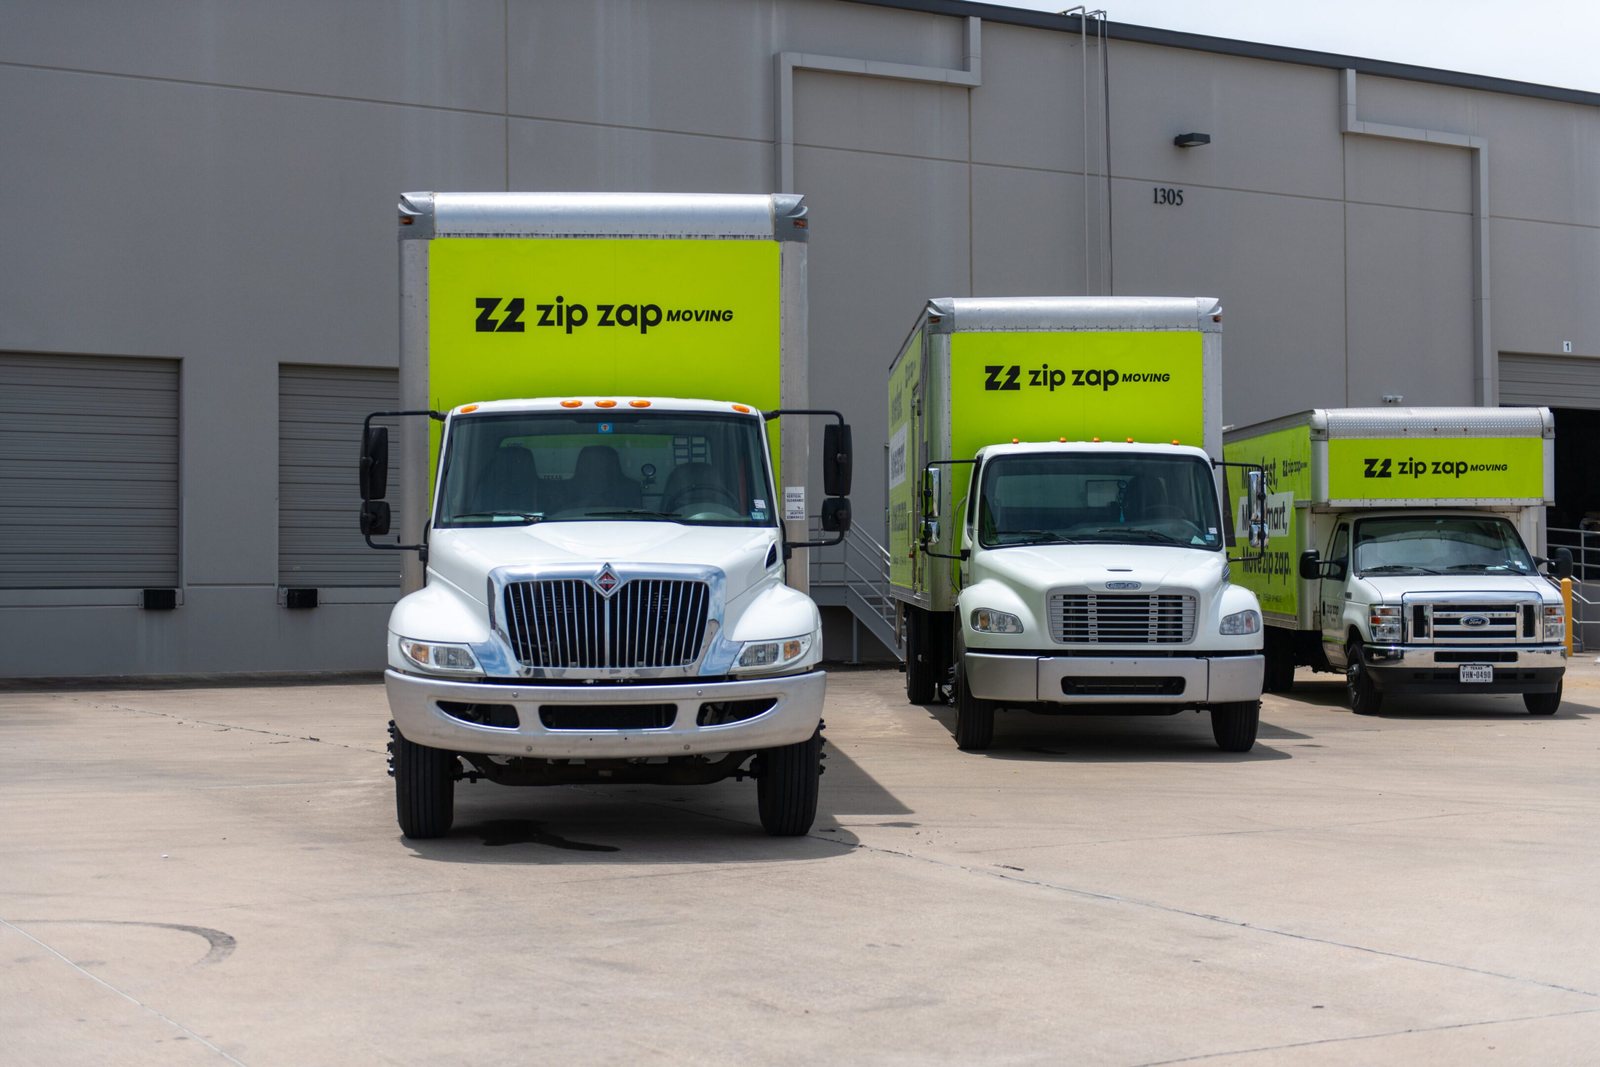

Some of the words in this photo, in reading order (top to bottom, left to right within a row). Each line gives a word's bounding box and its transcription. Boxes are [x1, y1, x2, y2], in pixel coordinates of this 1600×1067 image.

[1153, 187, 1184, 206] 1305
[536, 295, 588, 334] zip
[596, 303, 663, 334] zap
[666, 309, 734, 322] MOVING
[1028, 363, 1066, 391] zip
[1071, 368, 1119, 391] zap
[1121, 373, 1170, 383] MOVING
[1398, 456, 1427, 479] zip
[1431, 461, 1468, 479] zap
[1470, 464, 1508, 472] MOVING
